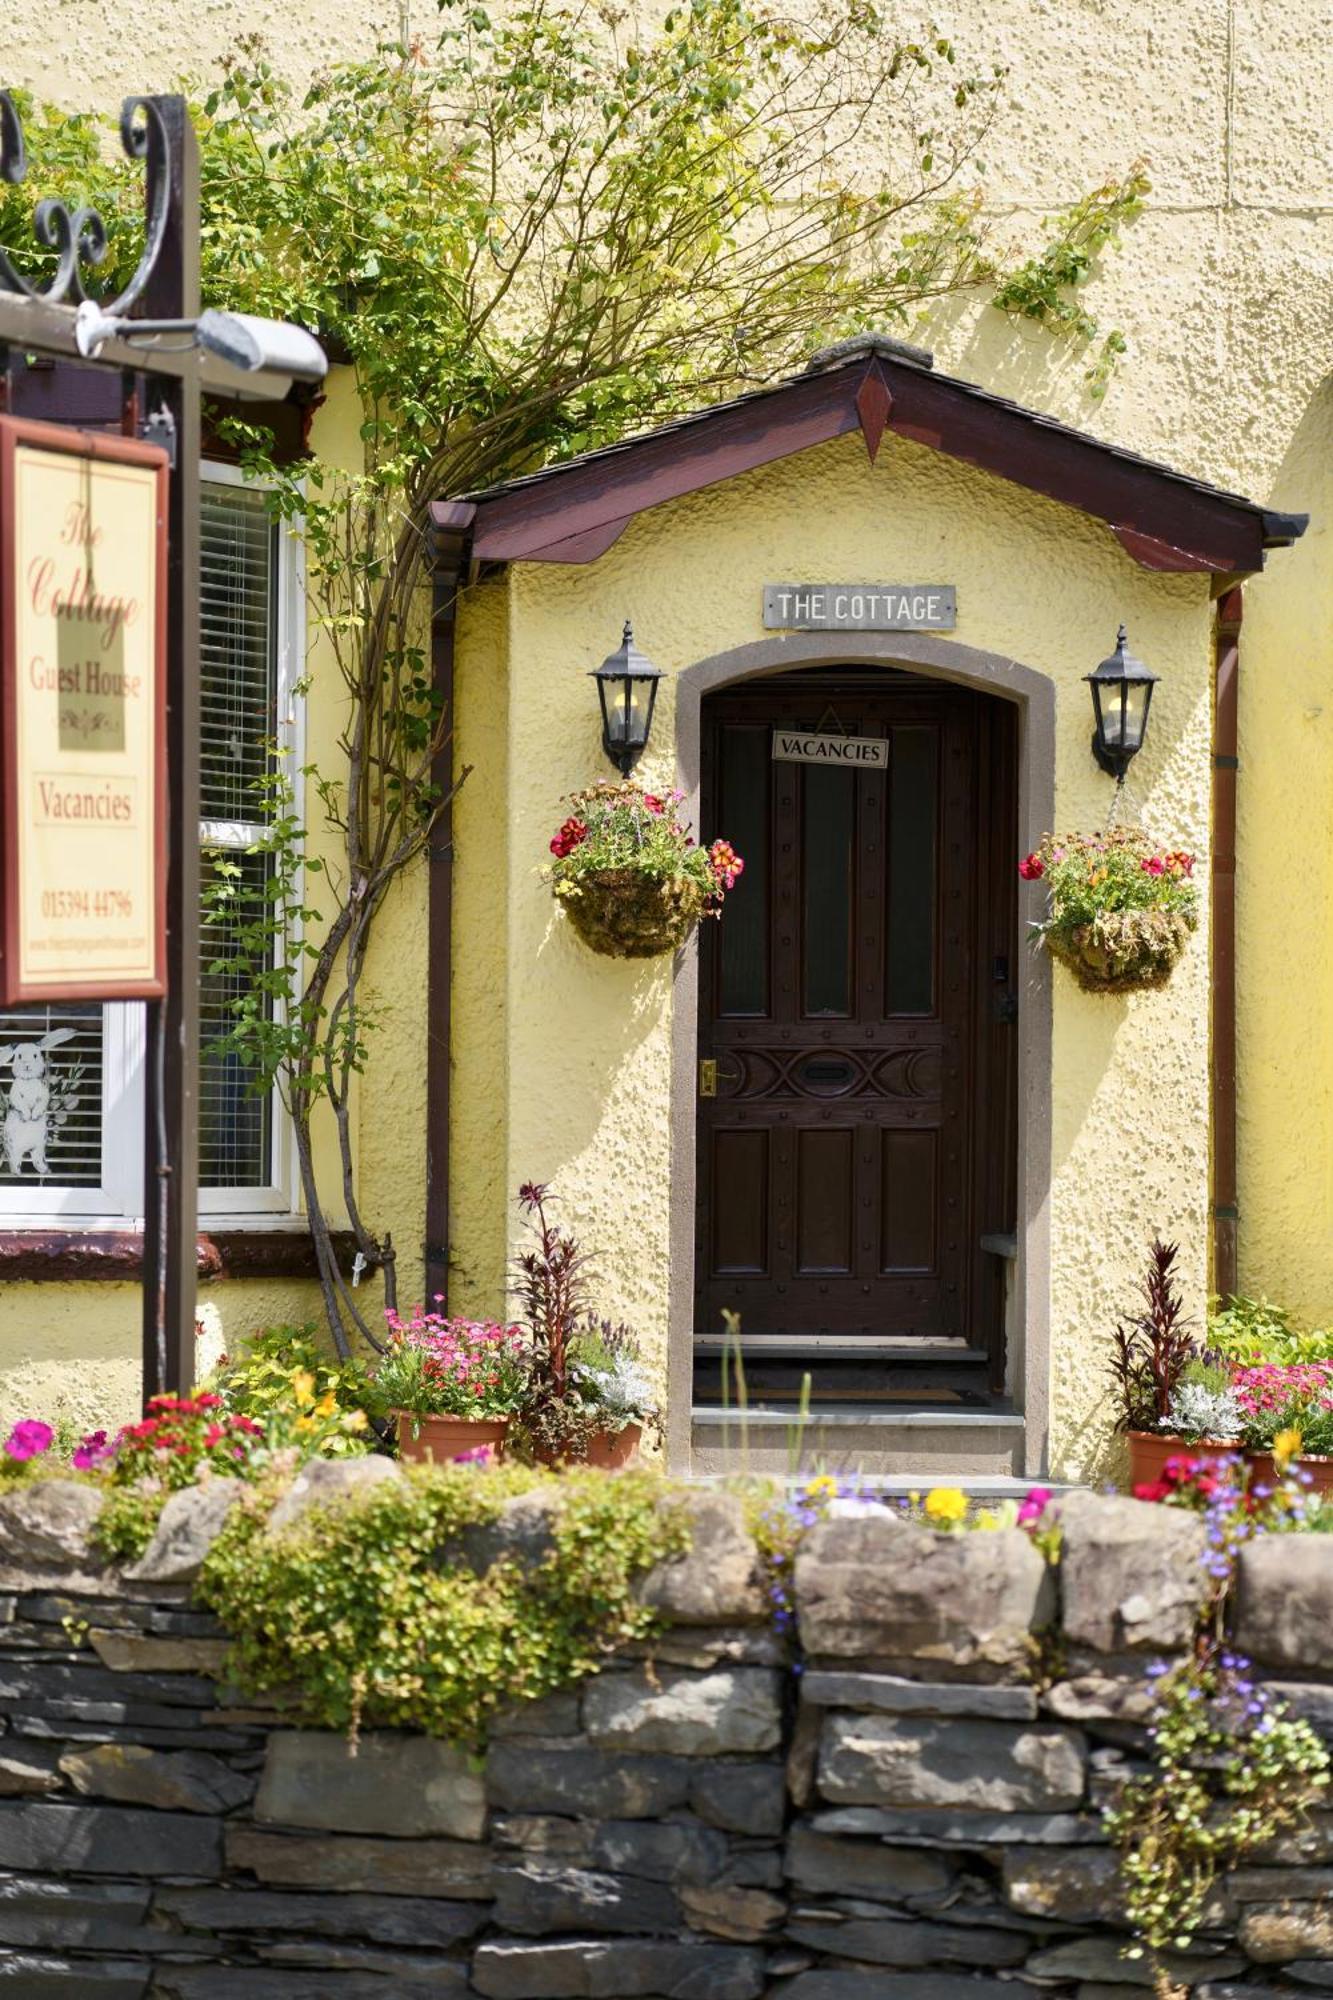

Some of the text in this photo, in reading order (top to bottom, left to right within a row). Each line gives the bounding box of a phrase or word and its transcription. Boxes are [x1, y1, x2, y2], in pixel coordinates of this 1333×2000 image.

[60, 501, 102, 546] The
[28, 555, 137, 651] Cottage
[778, 593, 941, 620] THE COTTAGE
[30, 655, 140, 698] Guest House
[782, 738, 880, 761] VACANCIES
[39, 781, 131, 820] Vacancies
